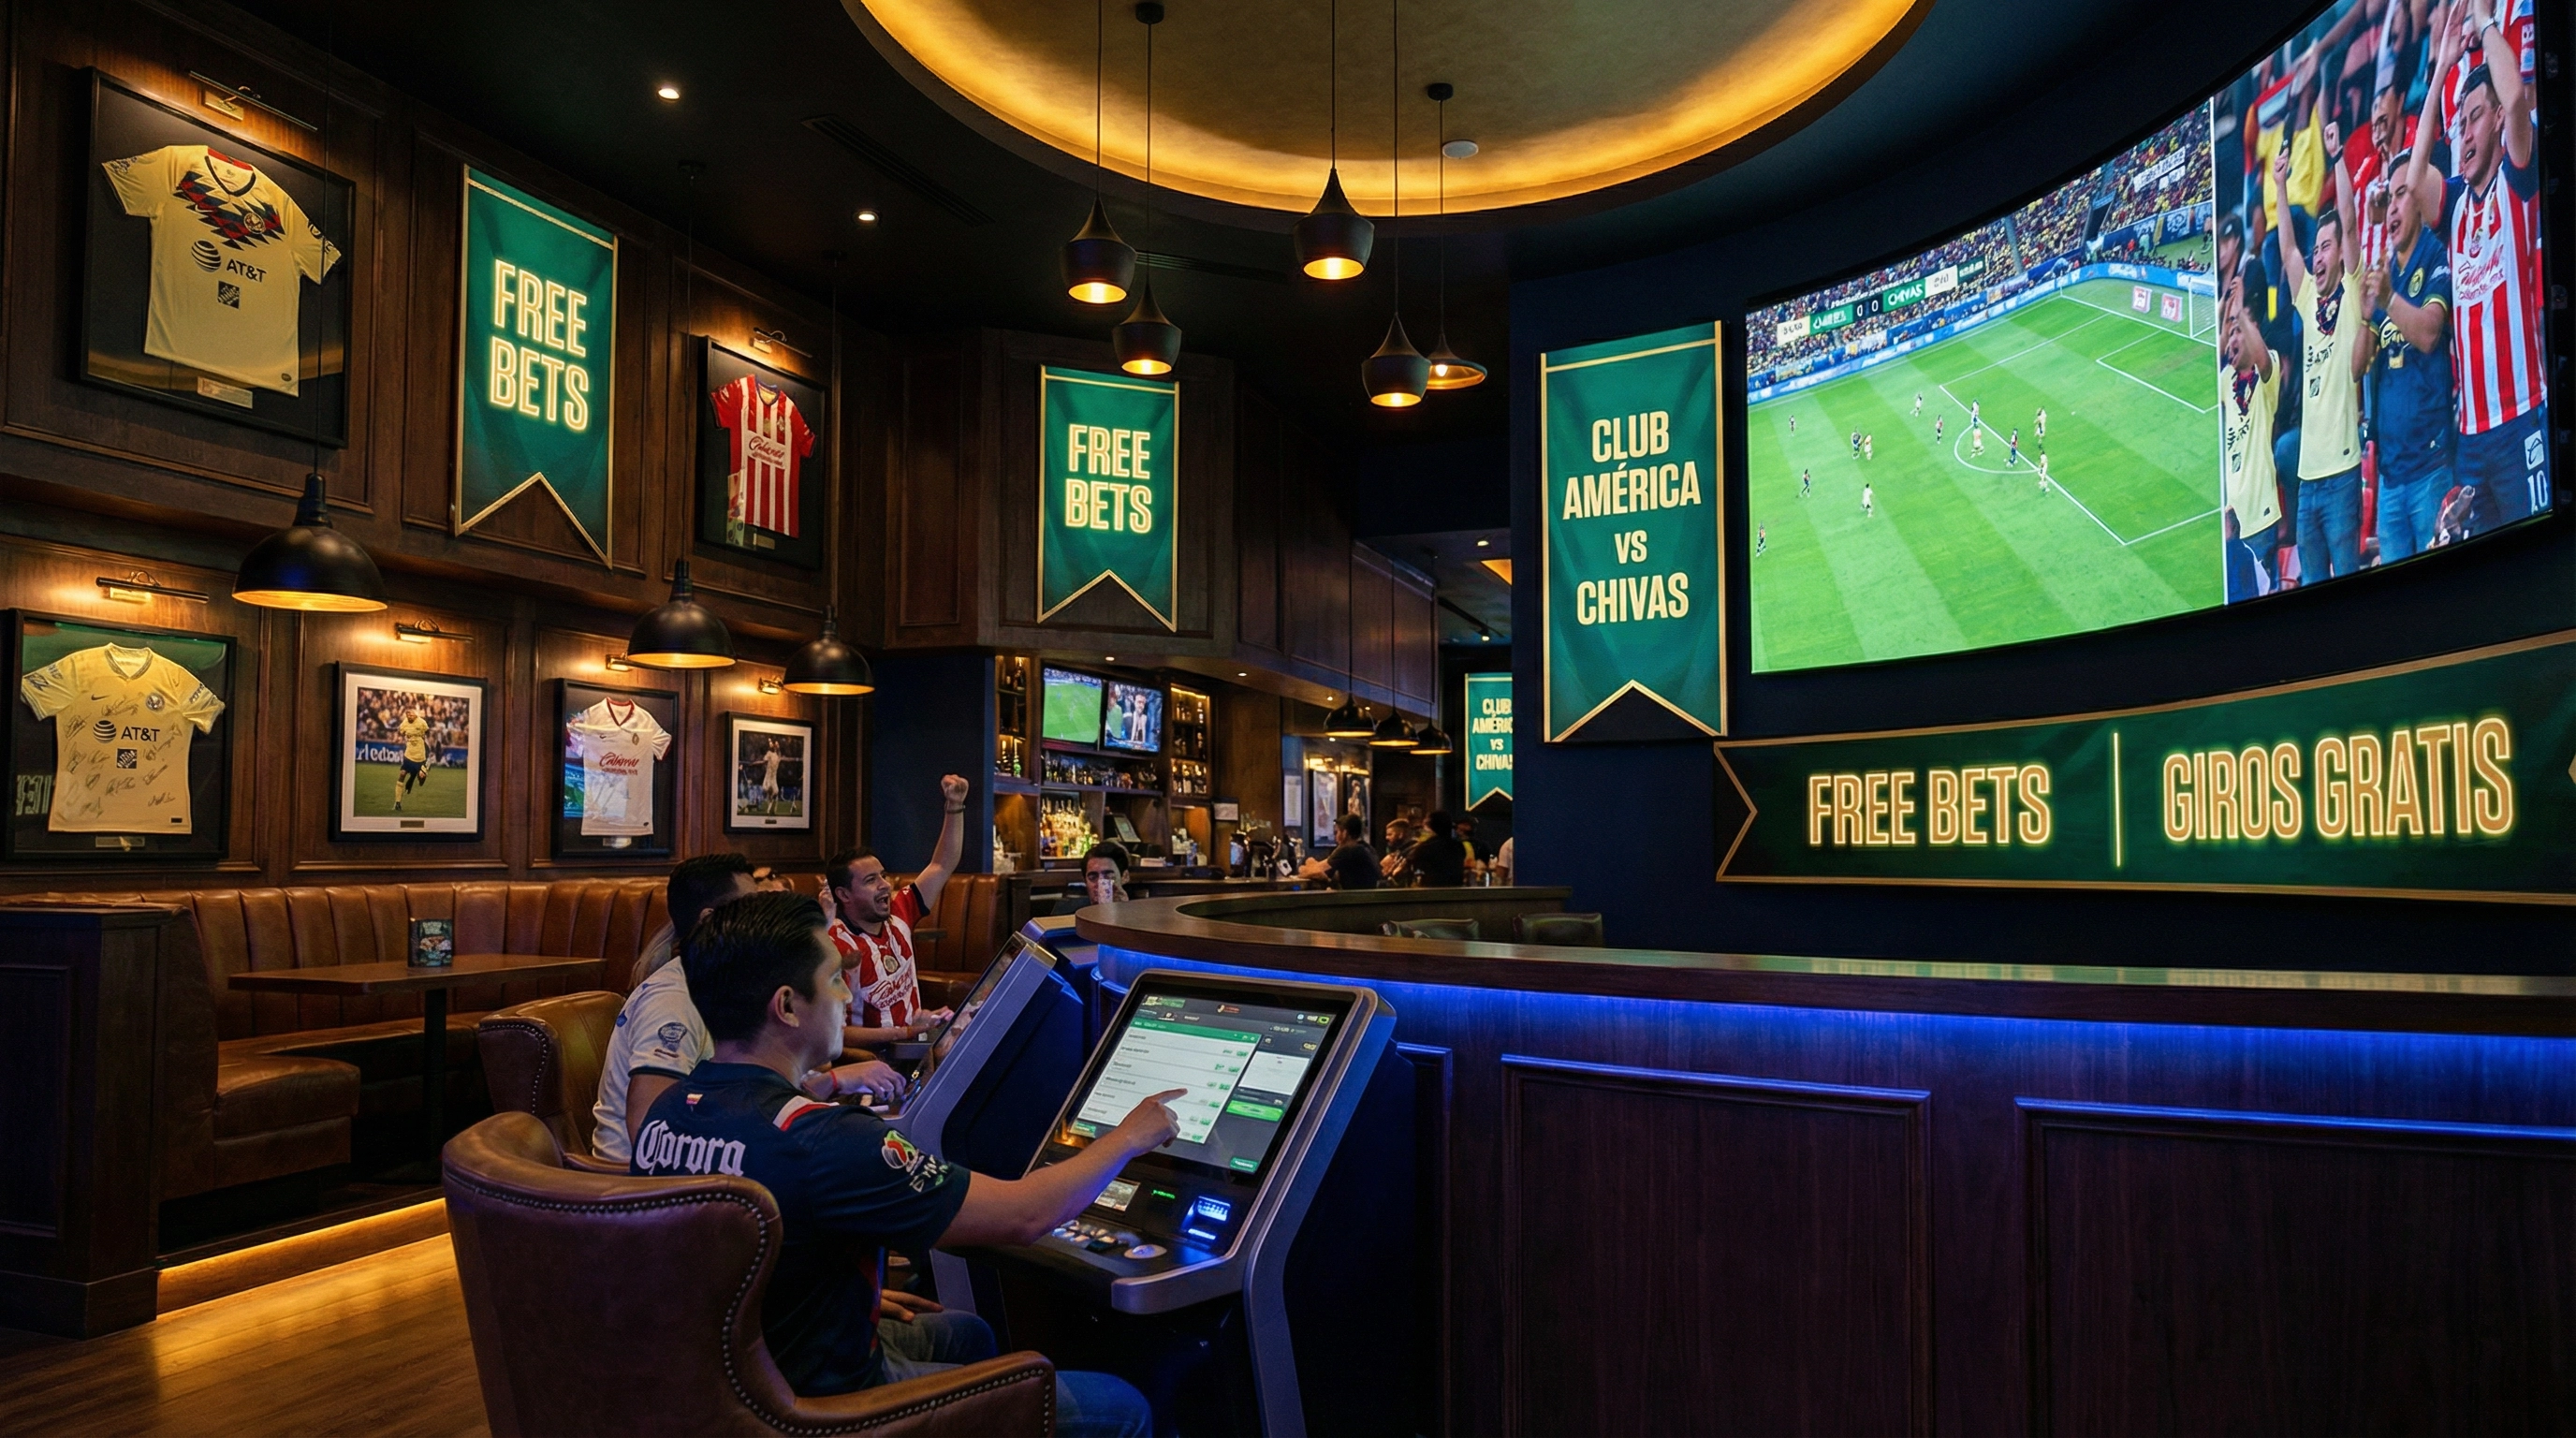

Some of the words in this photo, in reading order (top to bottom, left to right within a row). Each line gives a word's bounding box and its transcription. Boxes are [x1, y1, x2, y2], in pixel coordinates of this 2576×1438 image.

[227, 258, 267, 284] AT&T
[493, 258, 589, 359] FREE
[489, 335, 590, 432] BETS
[1068, 423, 1151, 480] FREE
[1592, 411, 1669, 462] CLUB
[1064, 477, 1152, 534] BETS
[1562, 462, 1702, 520] AMÉRICA
[1615, 530, 1647, 564] VS
[1576, 572, 1690, 625] CHIVAS
[1482, 697, 1513, 715] CLUB
[121, 726, 161, 742] AT&T
[1489, 738, 1504, 751] VS
[1808, 771, 1917, 845] FREE
[1928, 764, 2052, 845] BETS
[2162, 742, 2304, 843] GIROS
[2314, 717, 2514, 840] GRATIS
